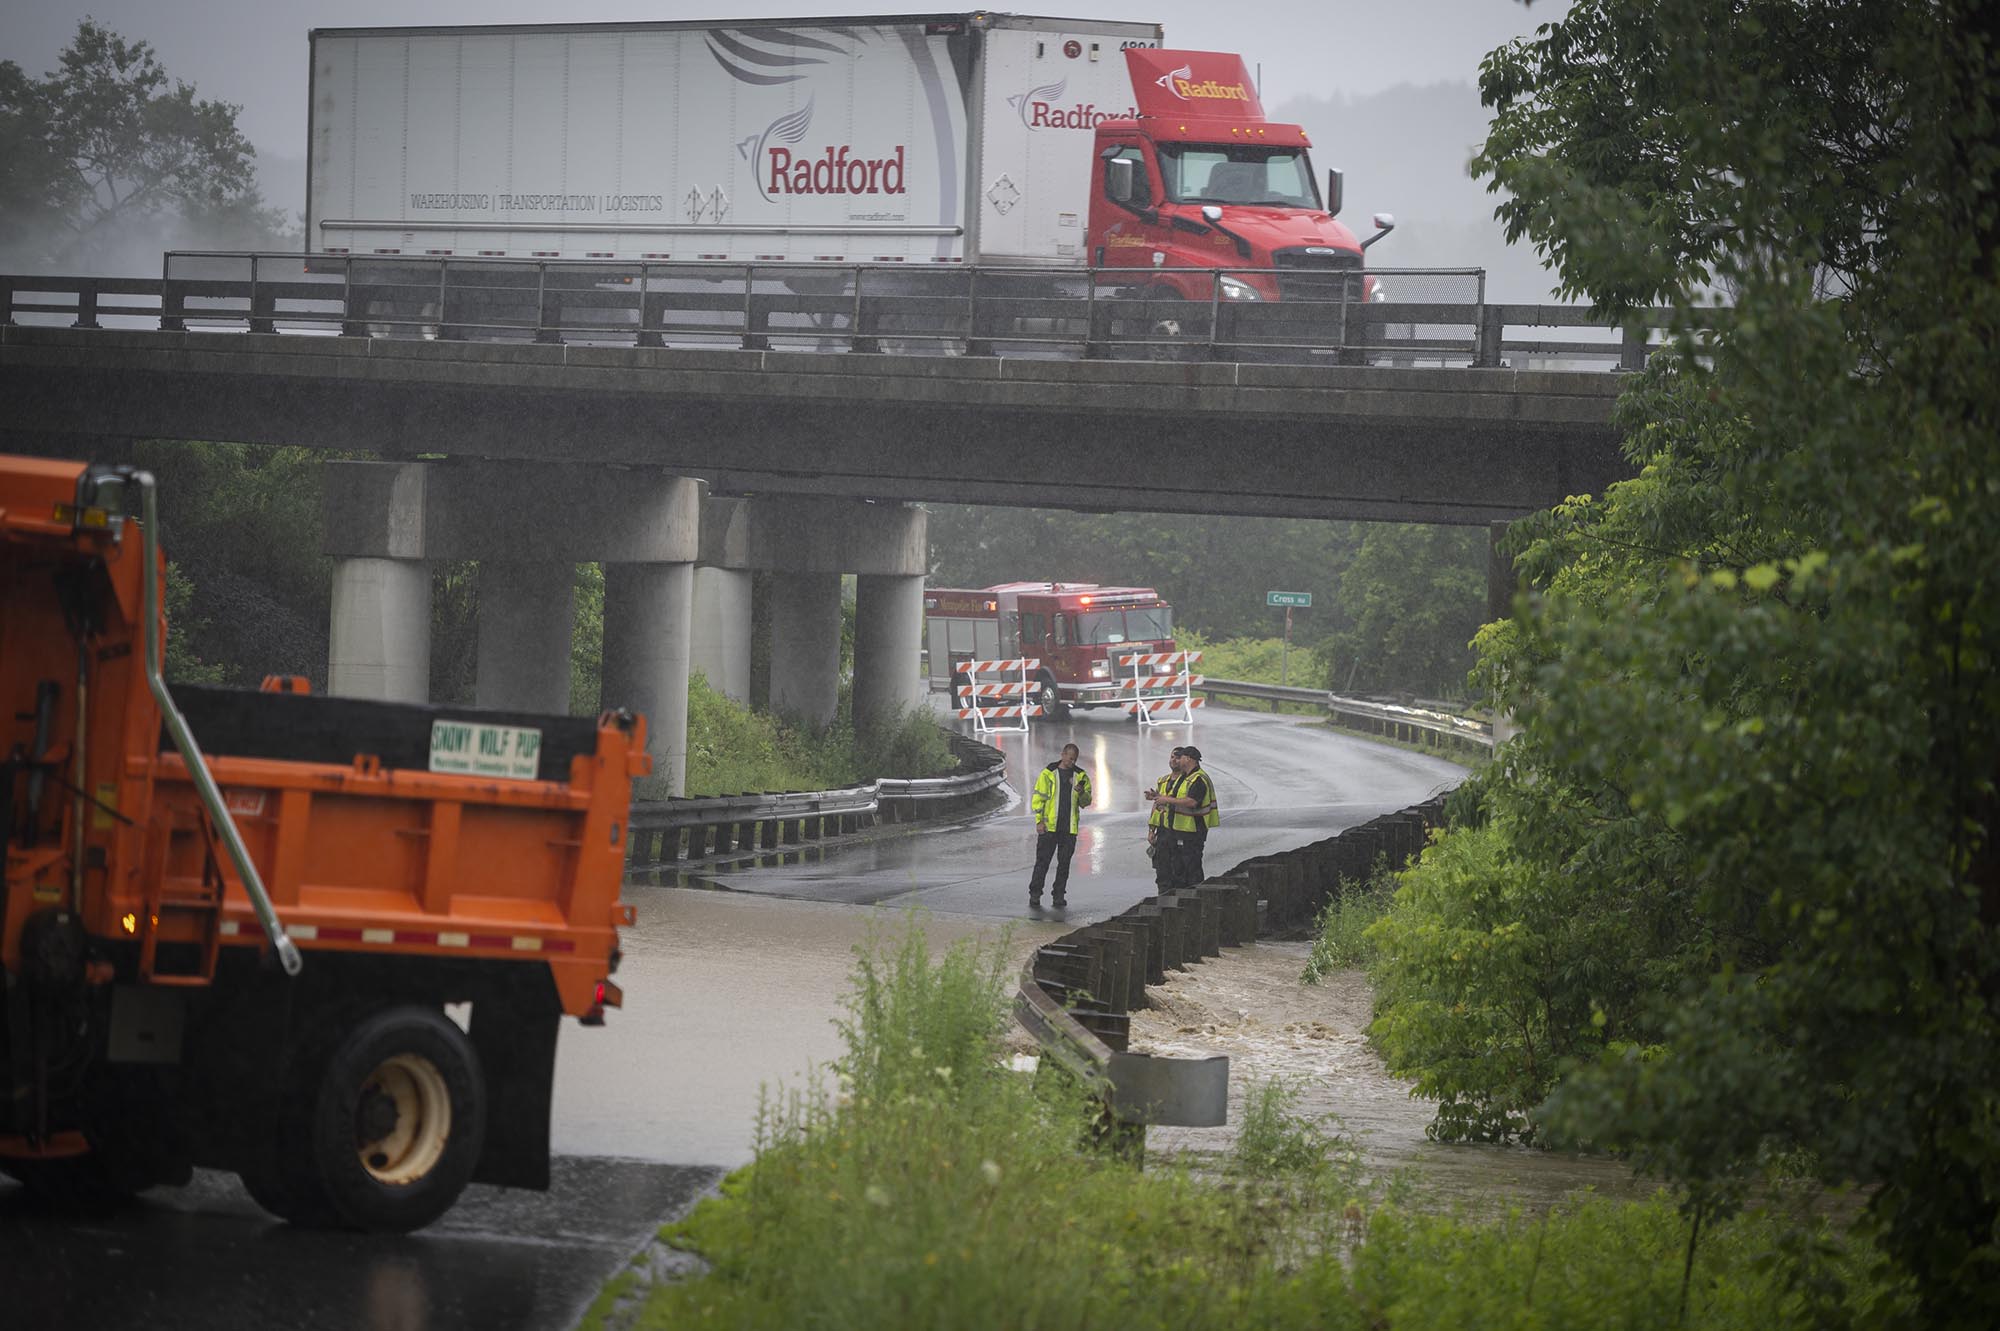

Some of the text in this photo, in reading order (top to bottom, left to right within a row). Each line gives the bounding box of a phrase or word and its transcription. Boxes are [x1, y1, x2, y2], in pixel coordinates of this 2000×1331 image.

[1174, 79, 1250, 101] Radford
[768, 146, 905, 194] Radford
[410, 193, 663, 211] WAREHOUSING TRANSPORTATION LOGISTICS
[1273, 594, 1295, 603] Cross
[431, 725, 472, 754] SNOWY
[516, 731, 541, 758] PUP
